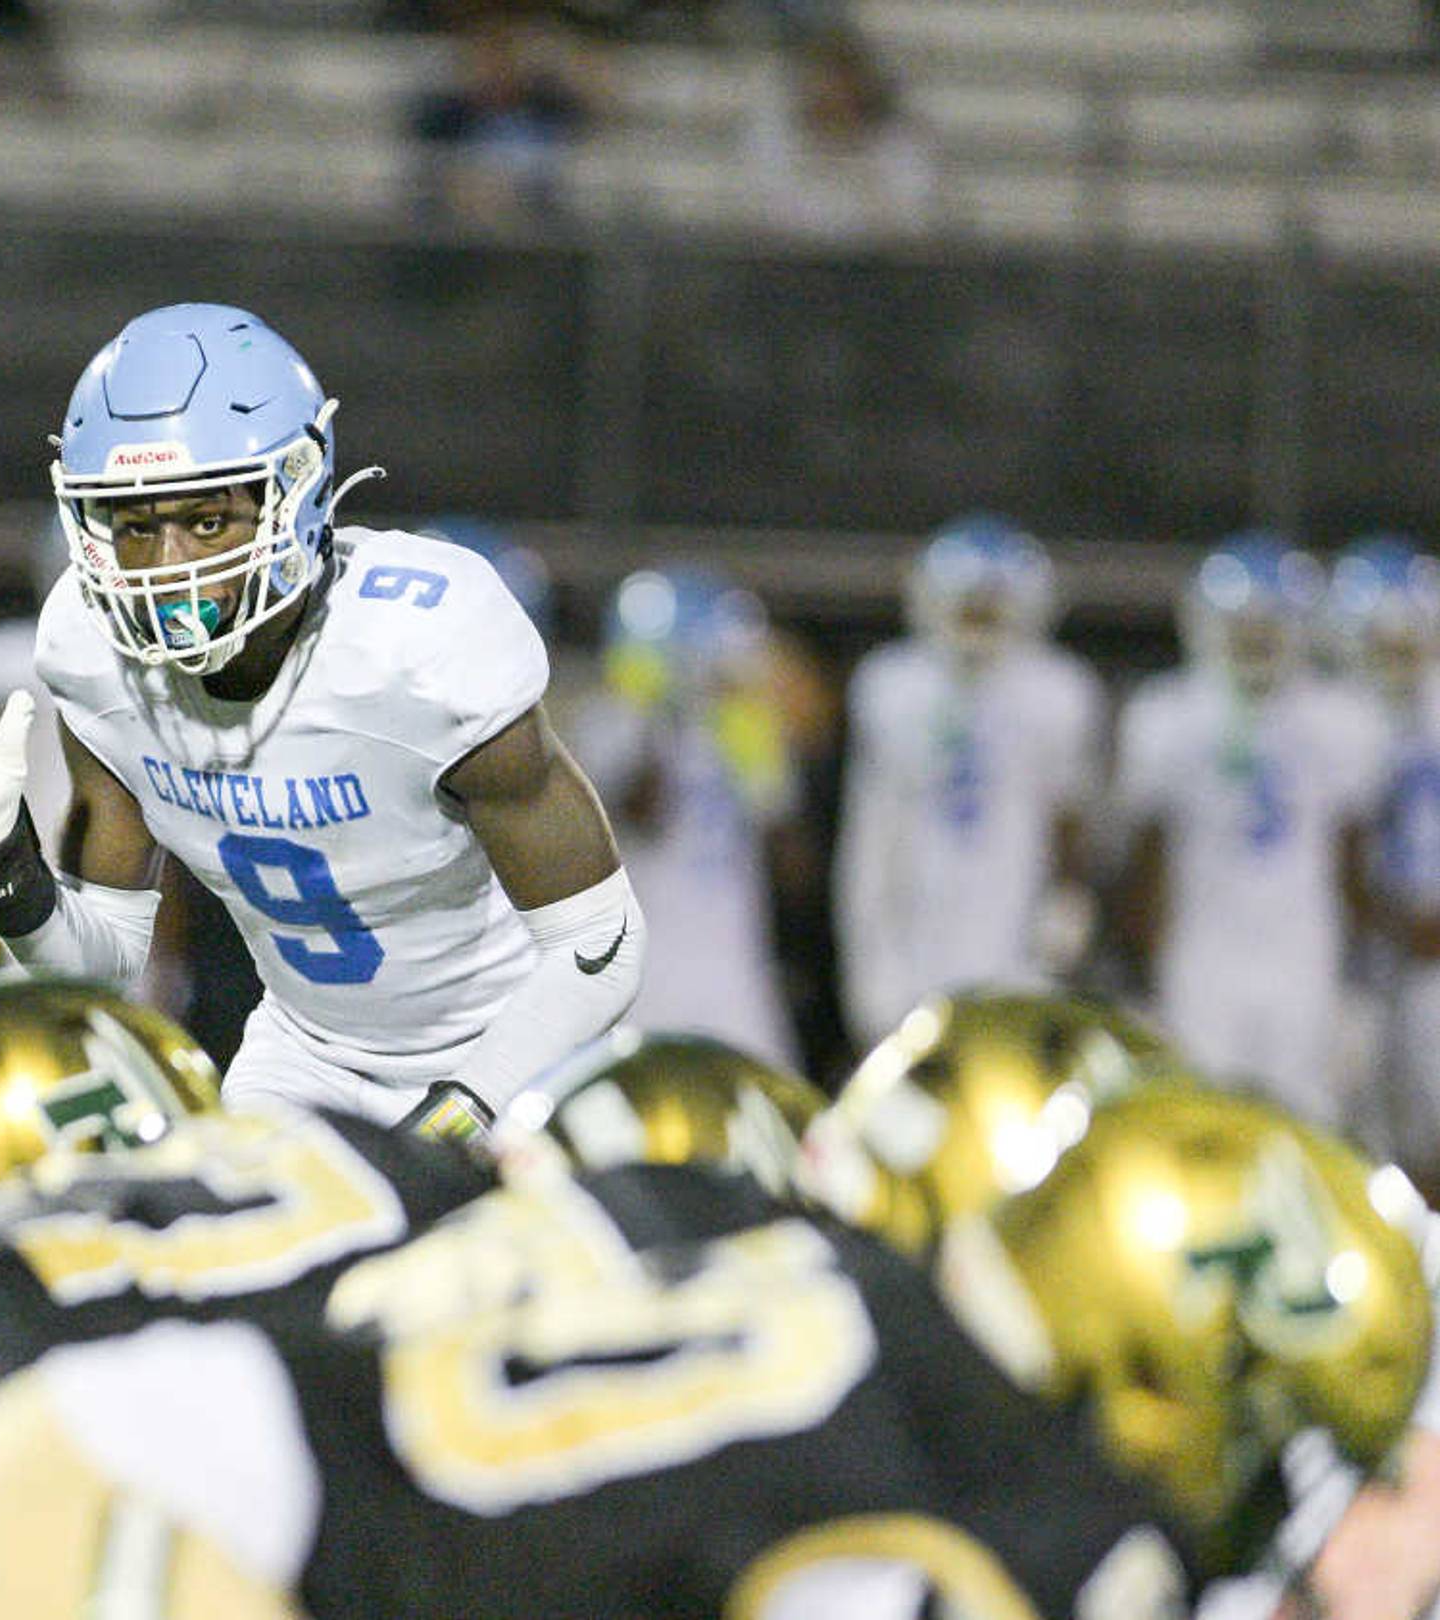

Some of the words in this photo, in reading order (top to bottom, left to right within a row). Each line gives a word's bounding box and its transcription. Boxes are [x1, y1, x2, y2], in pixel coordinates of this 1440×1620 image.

[358, 563, 450, 610] 9
[142, 754, 372, 831] CLEVELAND
[216, 830, 386, 986] 9
